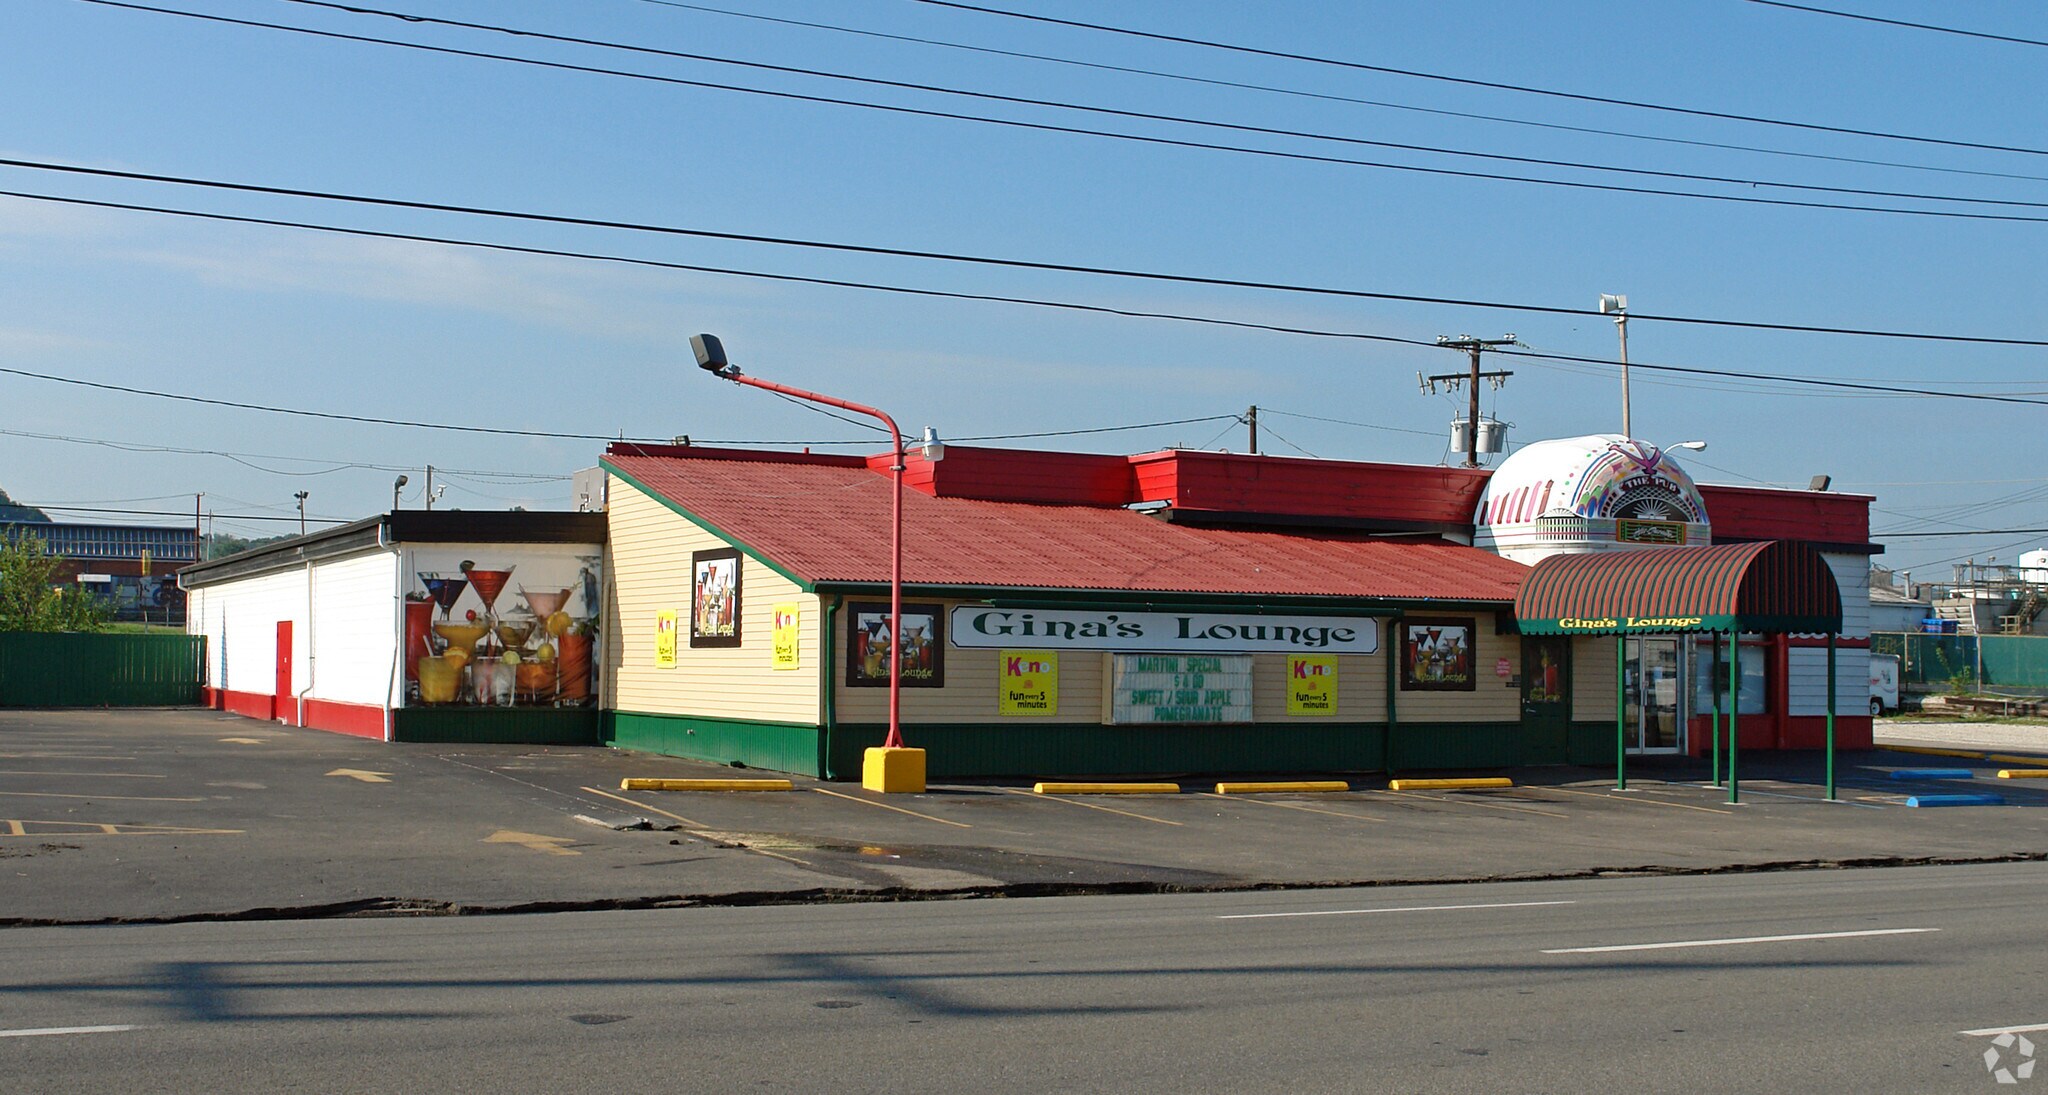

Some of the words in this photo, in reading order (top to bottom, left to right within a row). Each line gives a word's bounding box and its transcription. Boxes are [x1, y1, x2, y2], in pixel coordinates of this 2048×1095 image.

[1625, 477, 1650, 489] THE
[1655, 478, 1678, 492] PUB
[972, 611, 1144, 640] Gina's
[1174, 616, 1356, 647] Lounge
[1559, 618, 1618, 629] Gina's
[1626, 617, 1702, 627] Lounge
[1007, 656, 1050, 677] Keno
[1138, 657, 1179, 672] MARTINI
[1186, 658, 1222, 673] SPECIAL
[1293, 660, 1331, 680] Keno
[1010, 691, 1024, 700] fun
[1040, 691, 1045, 700] 5
[1131, 690, 1164, 705] SWEET
[1175, 690, 1198, 706] SOUR
[1204, 690, 1231, 706] APPLE
[1296, 692, 1309, 701] fun
[1322, 692, 1327, 701] 5
[1017, 701, 1047, 709] minutes
[1303, 701, 1328, 709] minutes
[1154, 706, 1222, 721] POMEGRANATE
